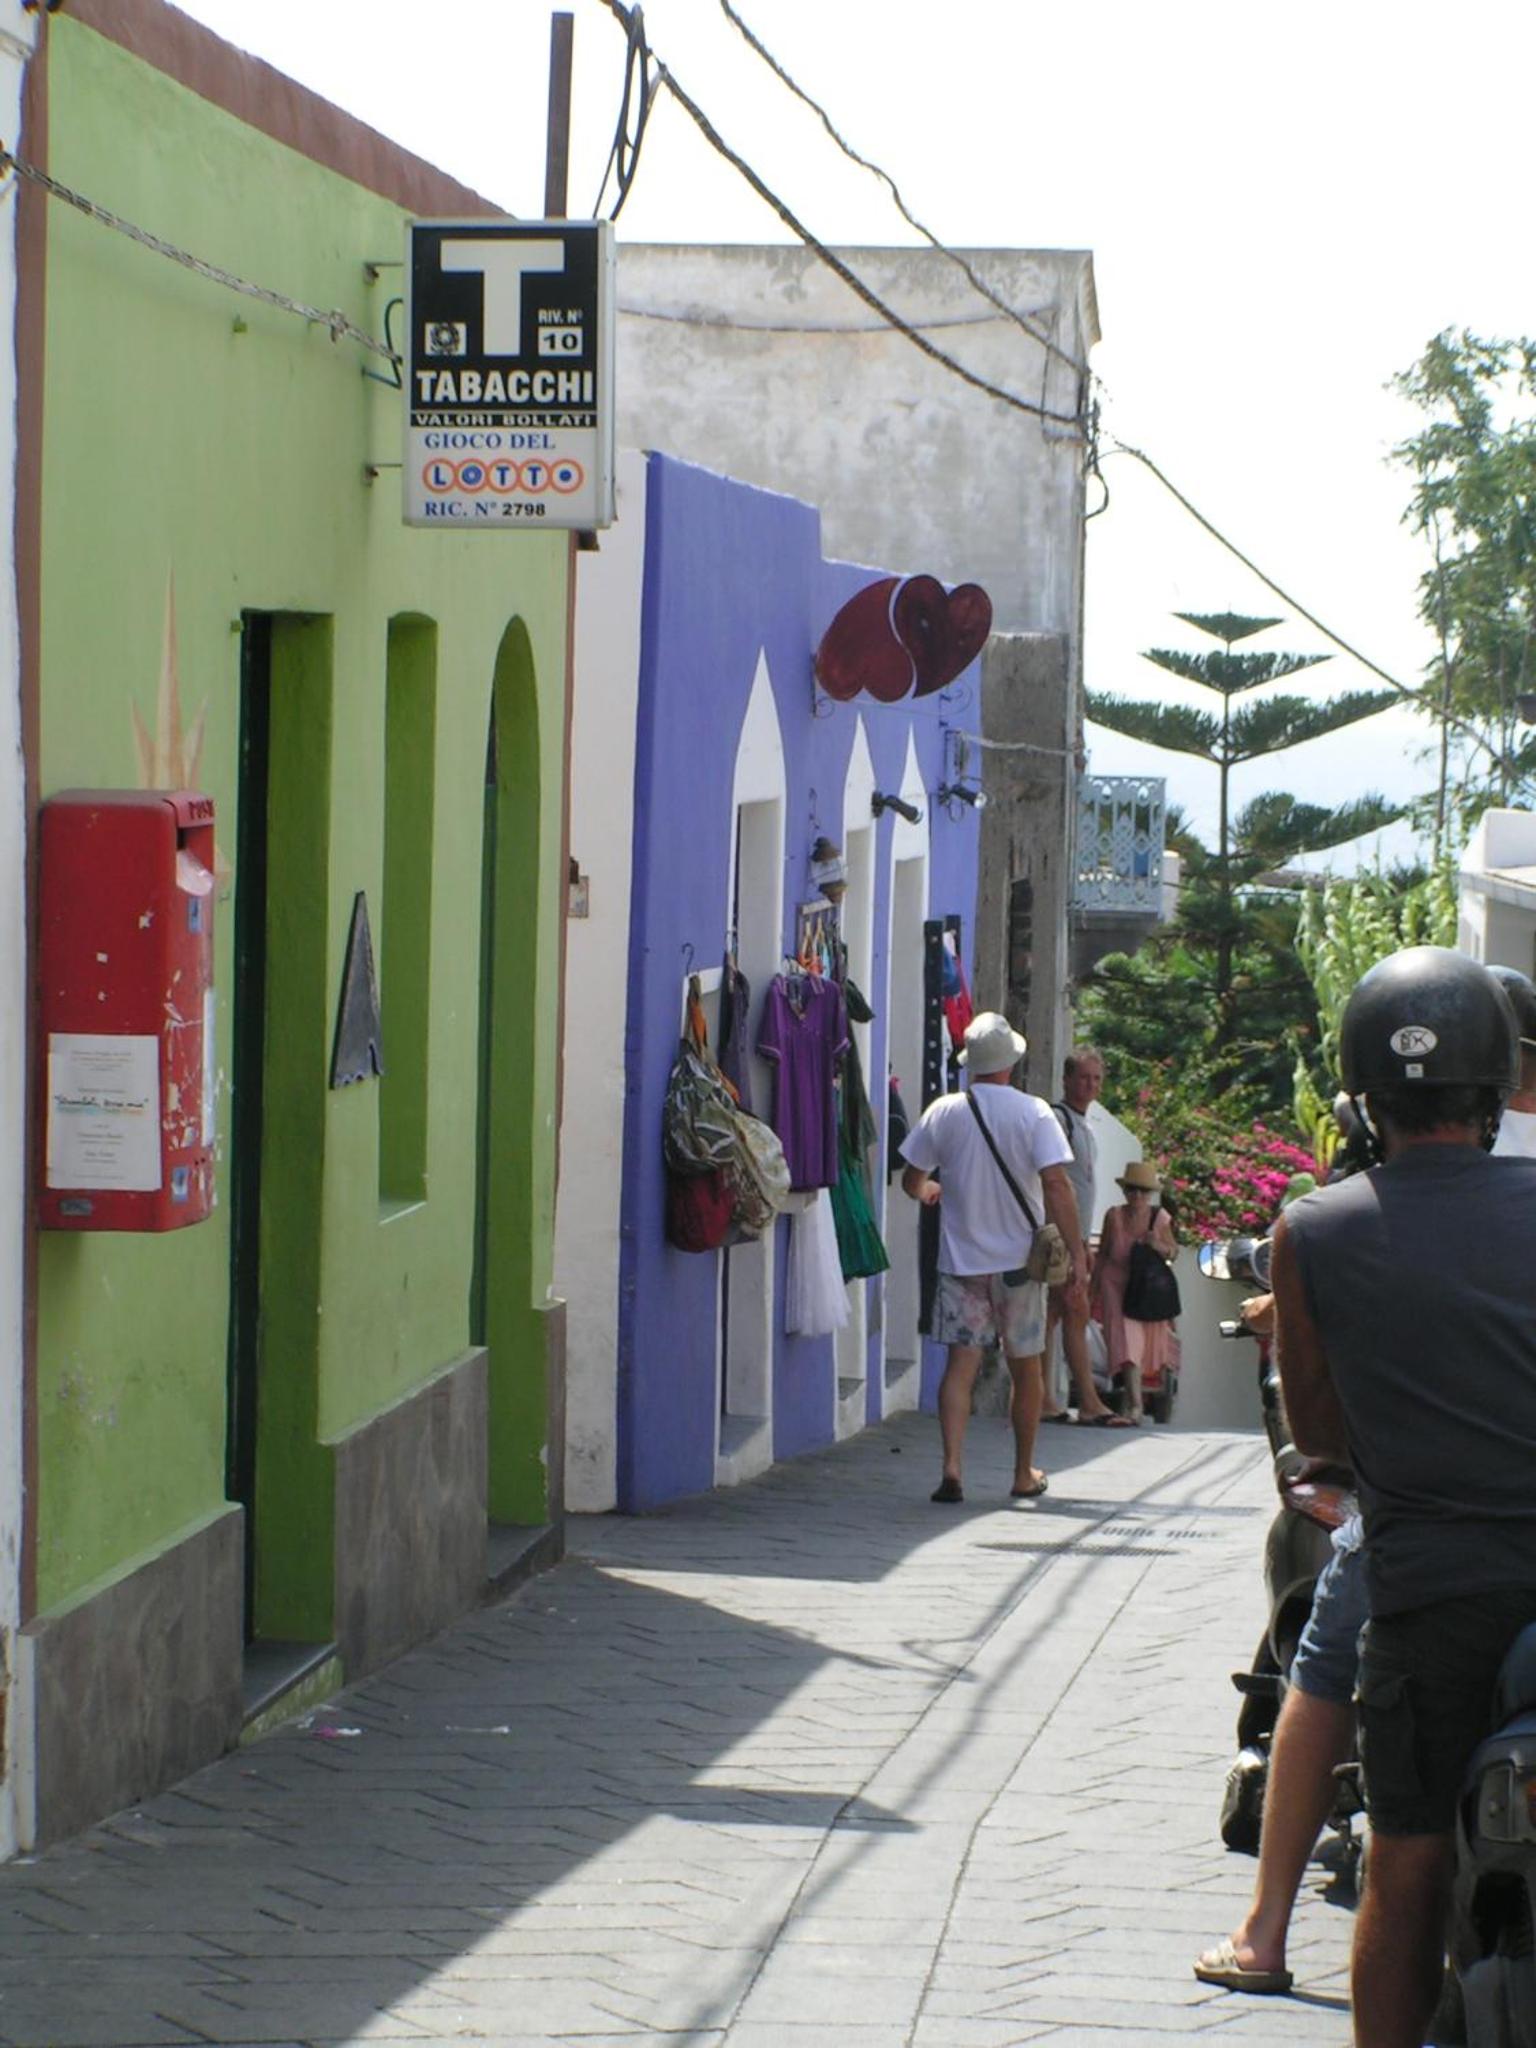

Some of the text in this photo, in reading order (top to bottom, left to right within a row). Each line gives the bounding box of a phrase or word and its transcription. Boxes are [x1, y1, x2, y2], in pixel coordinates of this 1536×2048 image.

[441, 239, 564, 355] T
[538, 309, 564, 324] RIV.
[543, 333, 578, 350] 10
[416, 370, 592, 402] TABACCHI
[416, 414, 591, 426] VALORI BOLLATI
[424, 433, 556, 449] GIOCO DEL
[425, 460, 581, 492] LOTTO
[425, 502, 467, 517] RIC.
[502, 503, 545, 517] 2798
